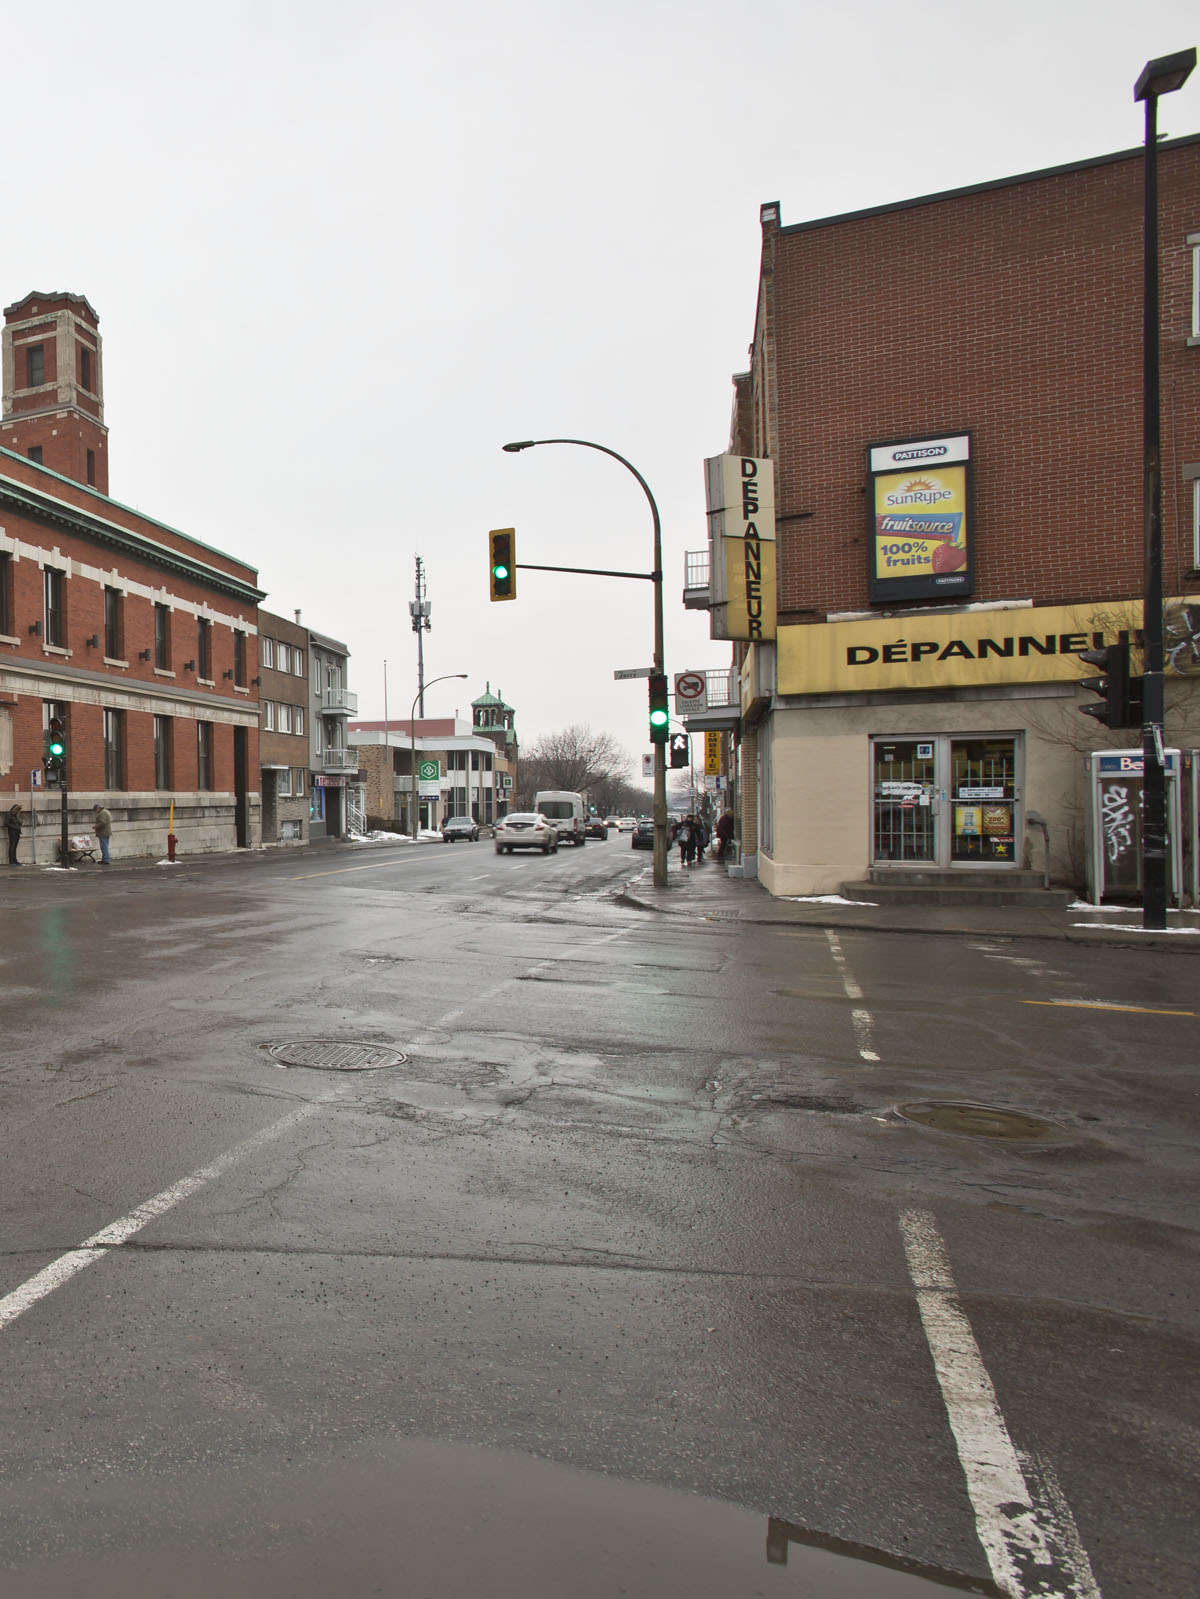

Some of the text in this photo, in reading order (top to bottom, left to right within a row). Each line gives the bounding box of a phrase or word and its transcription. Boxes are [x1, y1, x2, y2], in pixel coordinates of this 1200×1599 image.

[895, 447, 945, 461] PATTISON
[887, 489, 952, 506] SunRype
[880, 516, 954, 533] fruitsource
[741, 458, 762, 639] DÉPANNEUR
[881, 541, 928, 556] 100%
[886, 555, 931, 568] fruits
[846, 629, 1144, 665] DÉPANNEU
[708, 732, 717, 769] OMBERIE
[1120, 757, 1144, 770] Be
